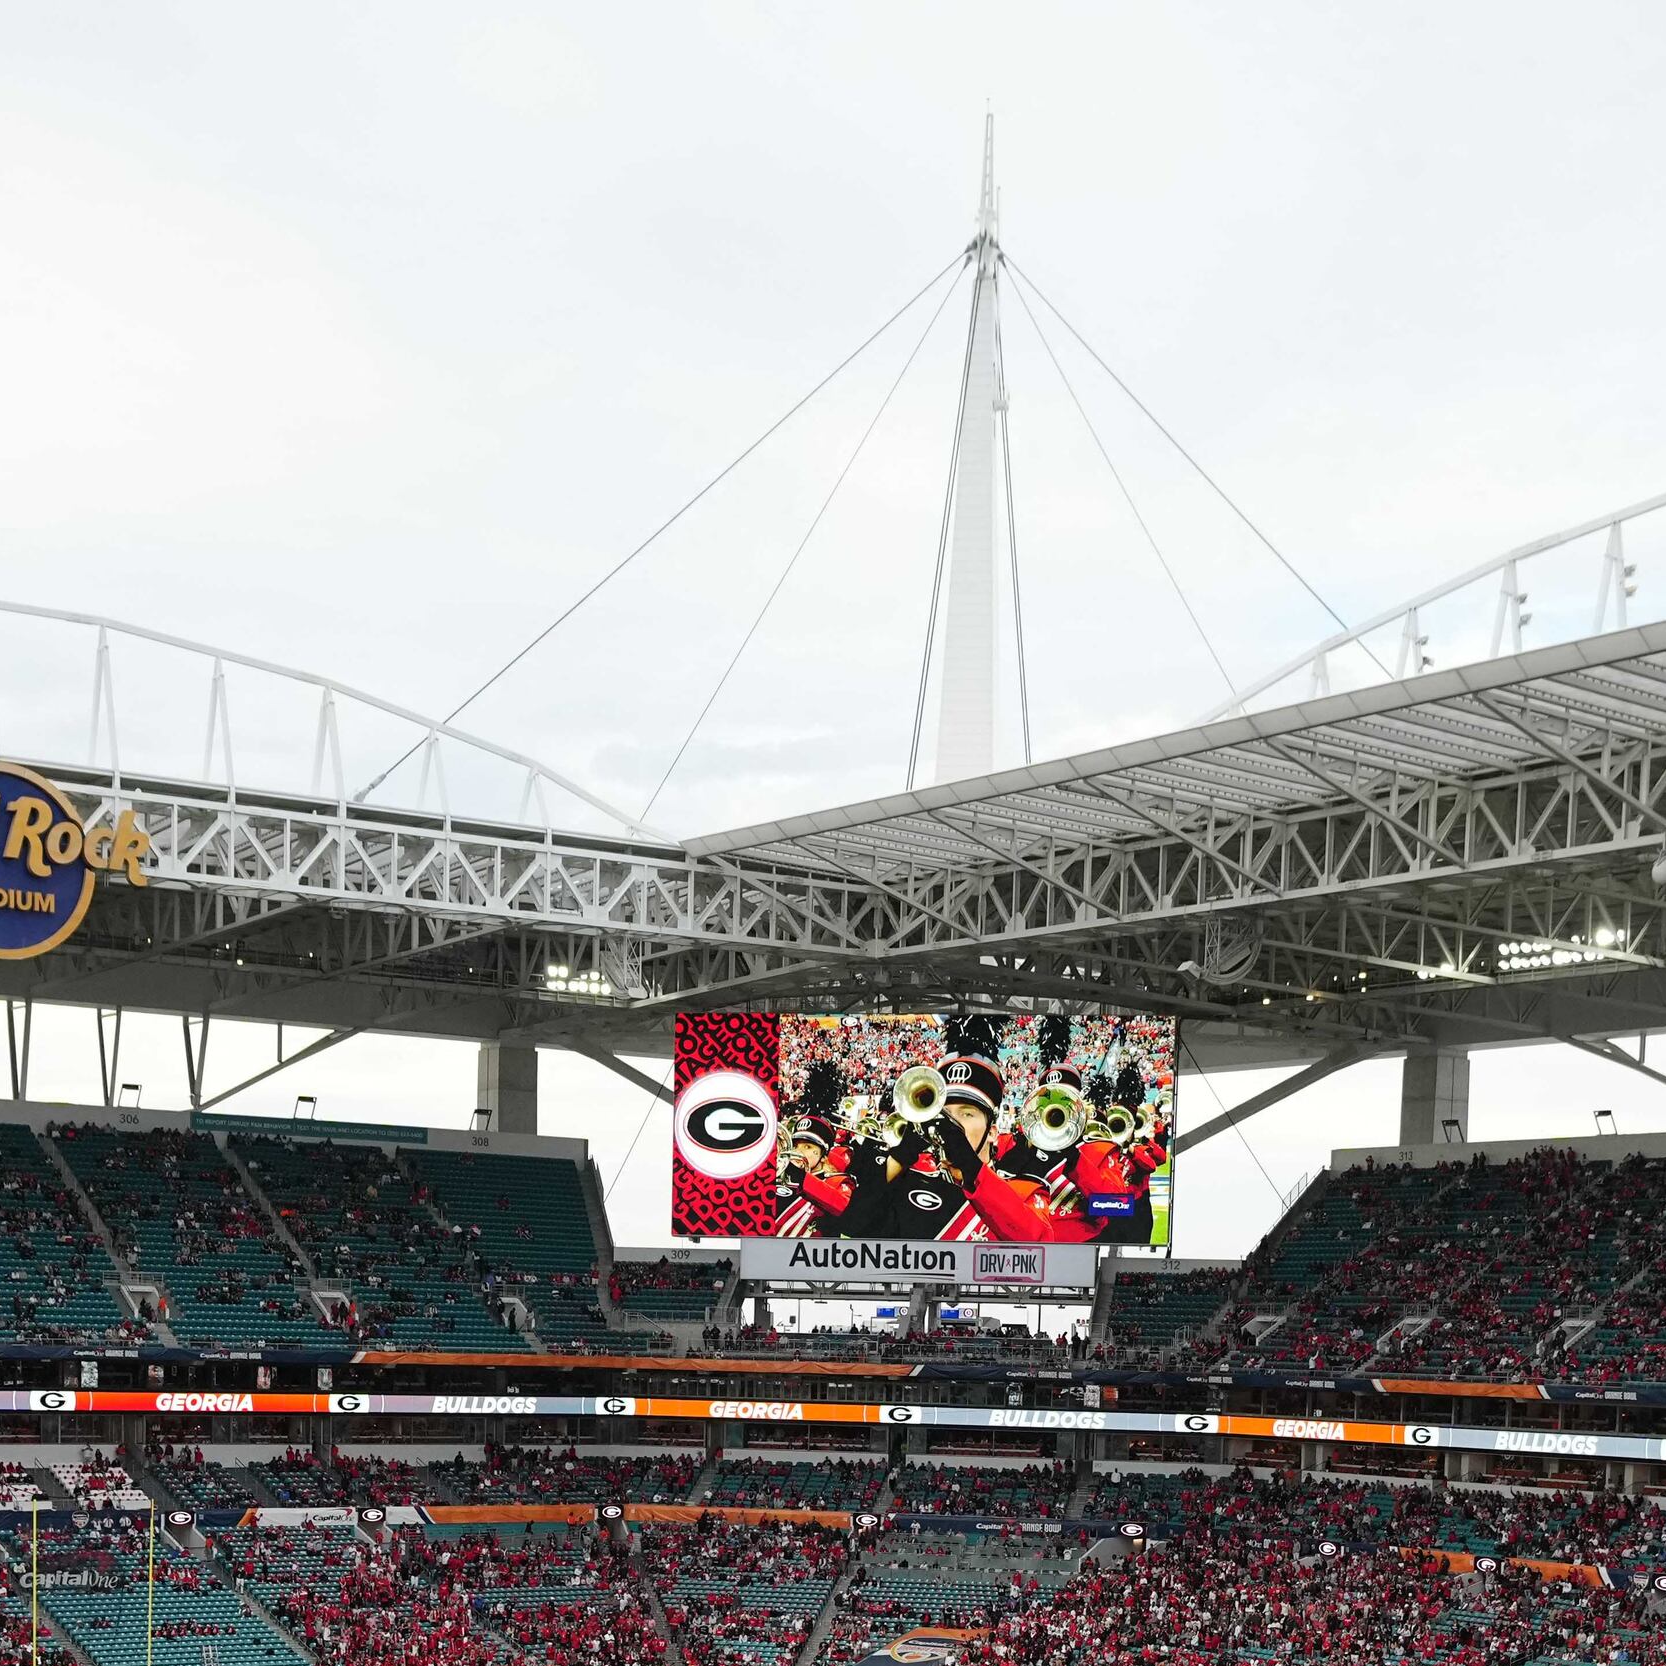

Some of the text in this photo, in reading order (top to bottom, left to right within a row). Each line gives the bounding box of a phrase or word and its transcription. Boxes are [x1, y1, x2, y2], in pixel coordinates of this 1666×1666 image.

[6, 794, 149, 887] Rock
[120, 1113, 139, 1125] 306
[471, 1137, 489, 1147] 308
[1398, 1151, 1413, 1161] 313
[670, 1250, 690, 1260] 309
[789, 1241, 957, 1271] AutoNation
[980, 1254, 1037, 1274] DRV PNK
[1161, 1260, 1181, 1271] 312
[155, 1393, 254, 1412] GEORGIA
[432, 1396, 537, 1414] BULLDOGS
[709, 1400, 804, 1420] GEORGIA
[988, 1409, 1107, 1428] BULLDOGS
[1272, 1420, 1346, 1441] GEORGIA
[1494, 1431, 1598, 1455] BULLDOGS
